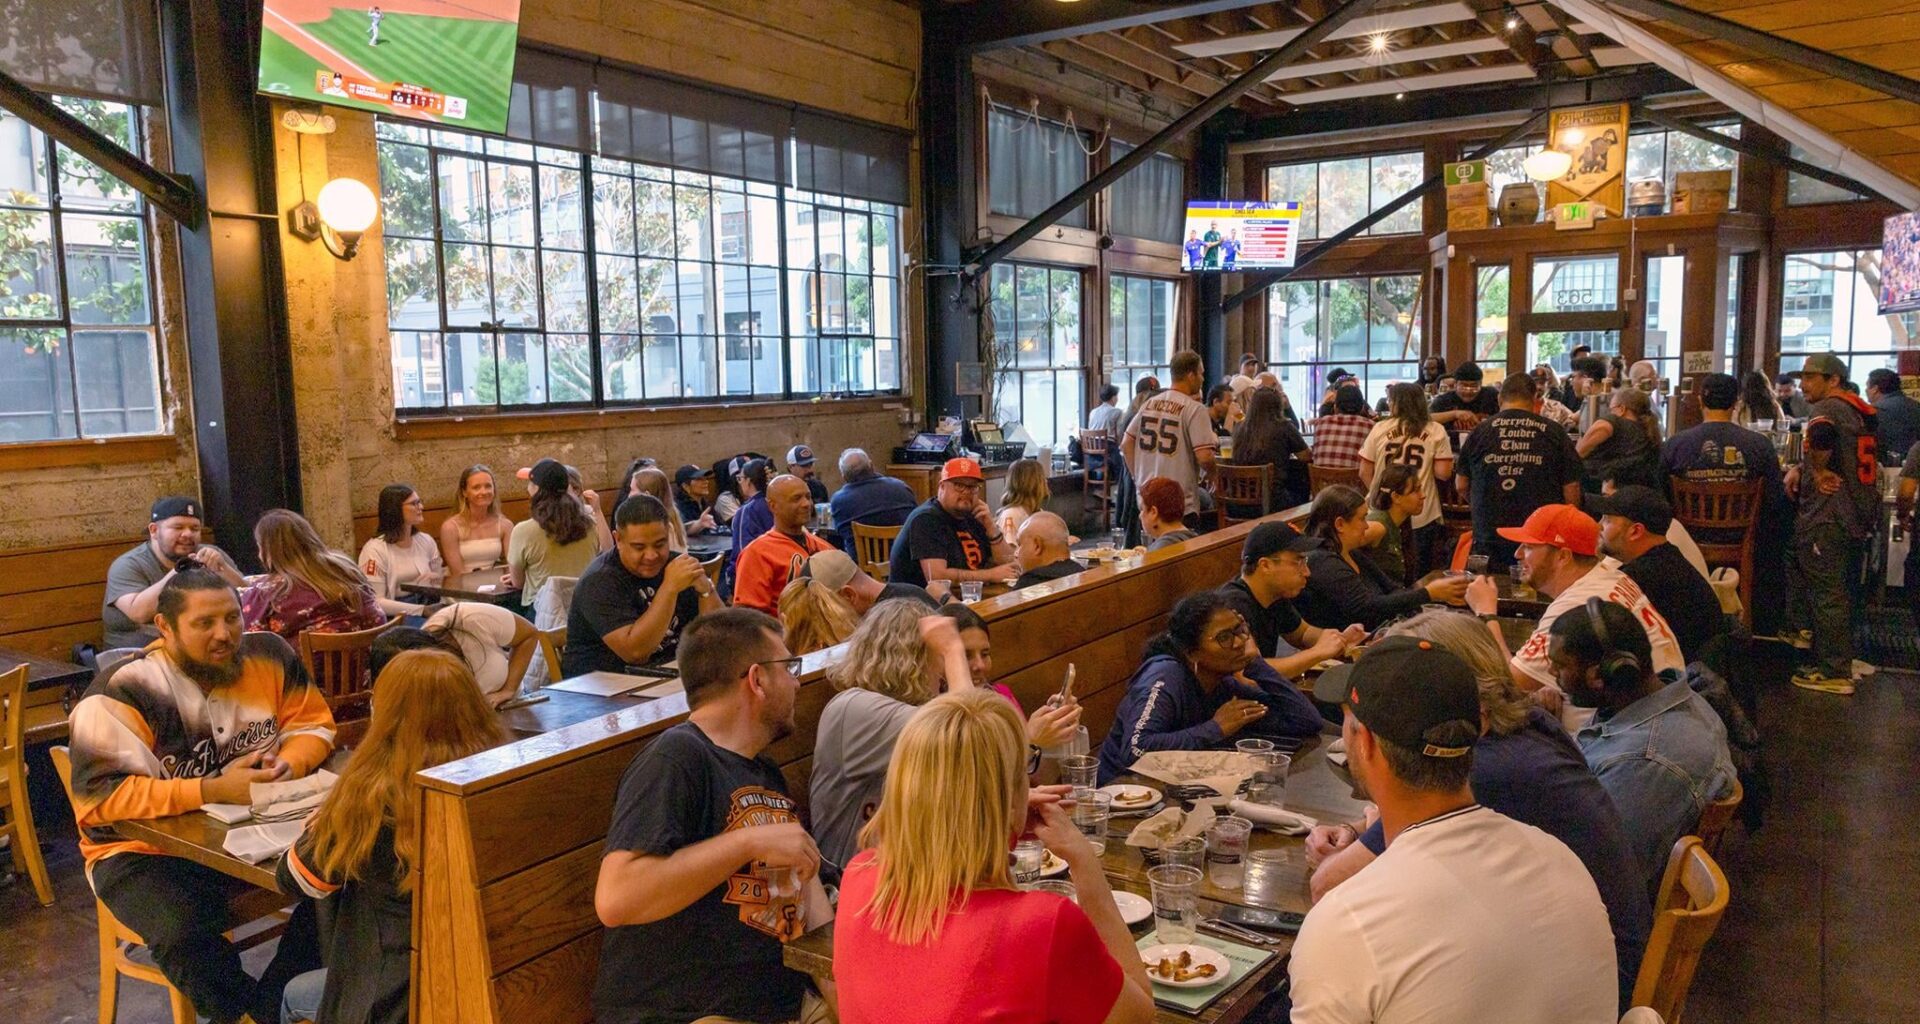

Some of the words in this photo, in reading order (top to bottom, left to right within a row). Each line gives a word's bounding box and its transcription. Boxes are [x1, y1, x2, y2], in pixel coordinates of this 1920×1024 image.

[1458, 165, 1472, 177] GB
[1563, 204, 1588, 221] EXIT
[1491, 417, 1547, 432] Everything
[1139, 416, 1179, 454] 55
[1386, 428, 1430, 442] CHAAN
[1499, 427, 1537, 438] Louder
[1501, 439, 1530, 451] Than
[1384, 442, 1426, 470] 26
[1484, 452, 1543, 465] Everything
[1497, 465, 1525, 476] Else
